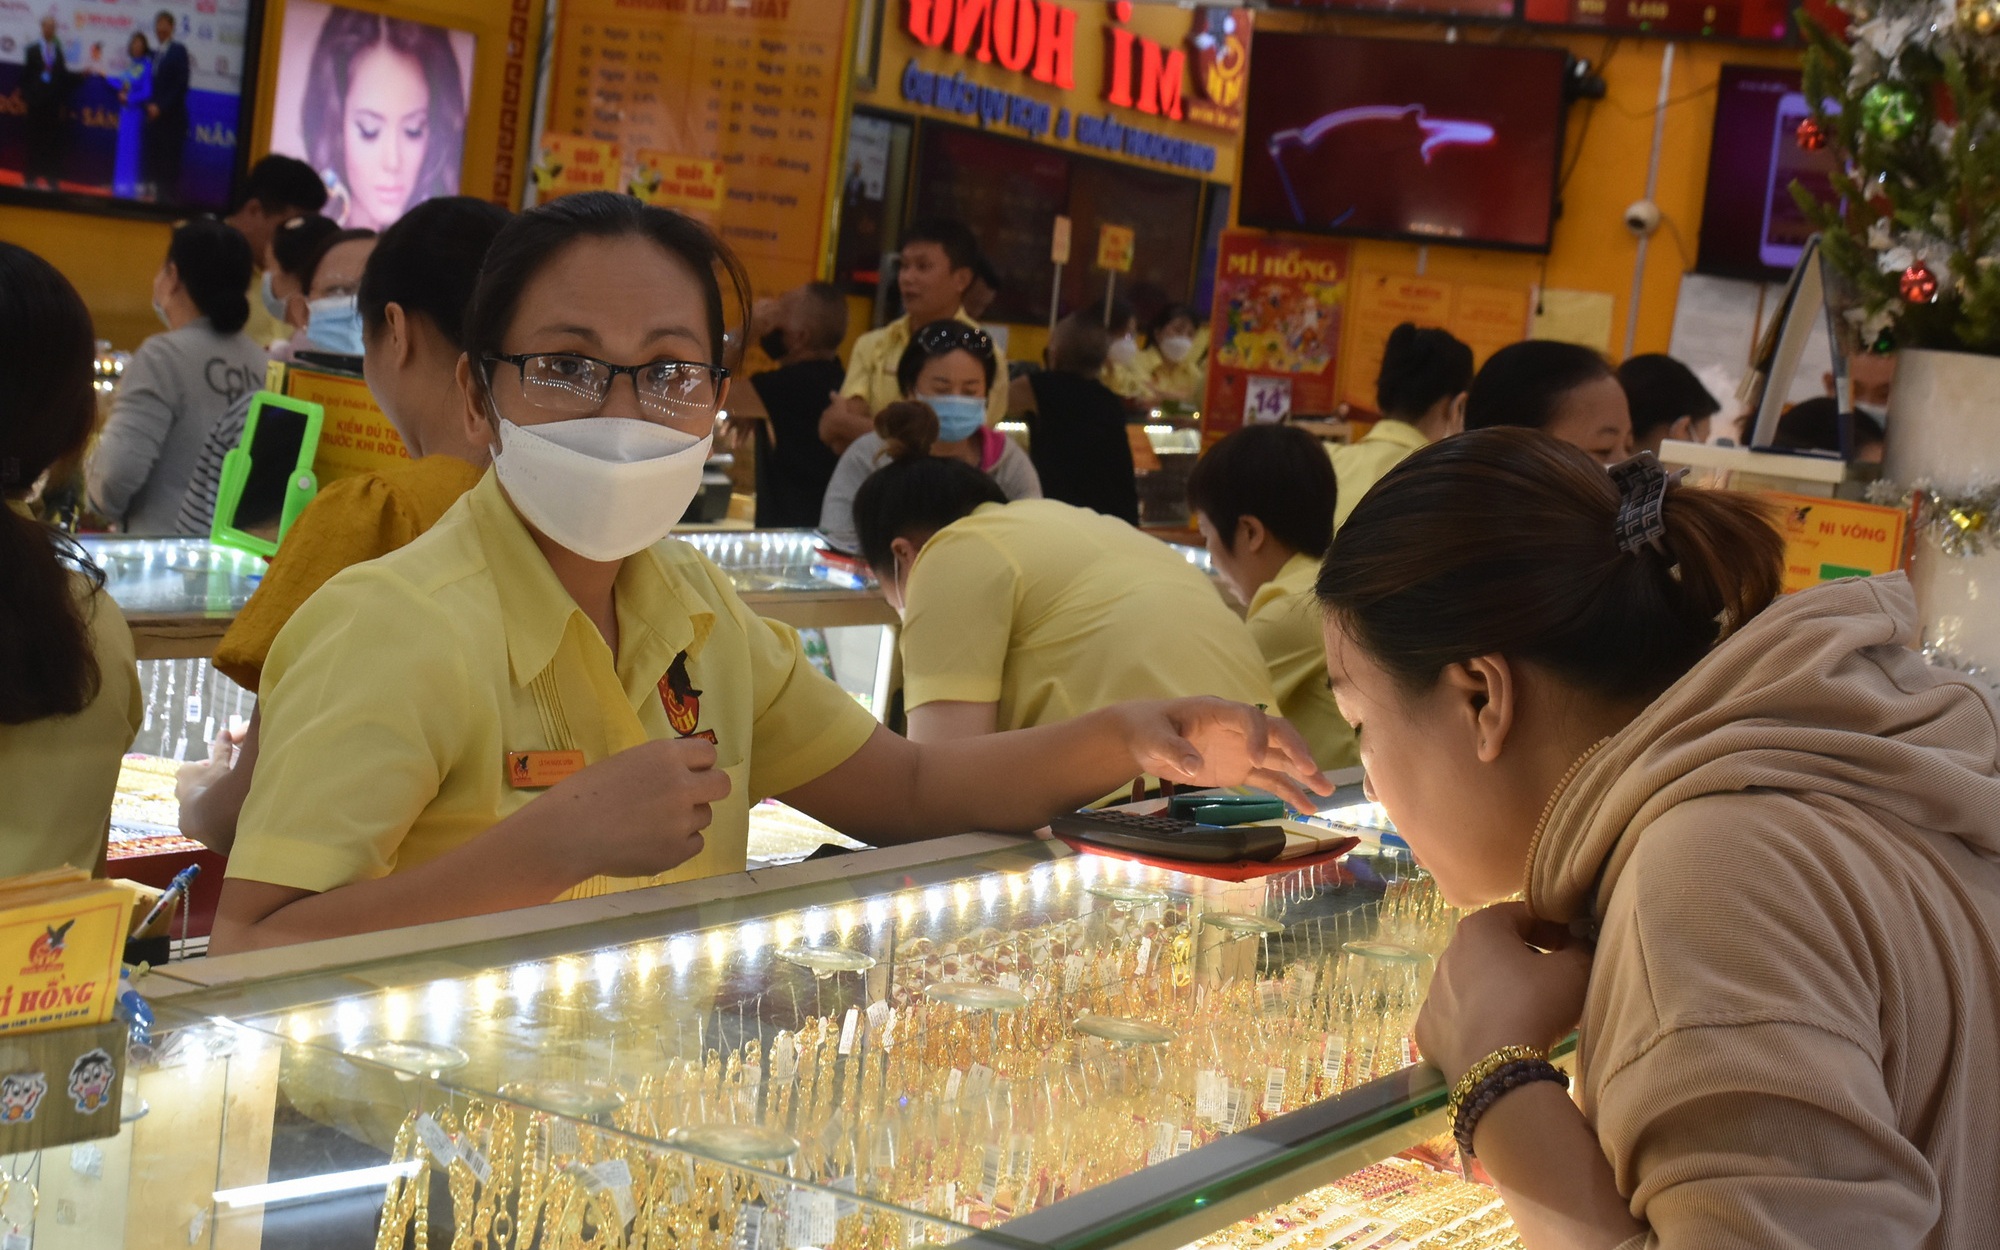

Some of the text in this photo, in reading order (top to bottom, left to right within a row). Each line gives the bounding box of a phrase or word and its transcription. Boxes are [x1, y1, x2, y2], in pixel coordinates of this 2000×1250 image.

[1254, 387, 1282, 415] 14
[356, 439, 374, 451] KHI
[1818, 521, 1836, 536] NI
[17, 973, 96, 1015] HỒNG
